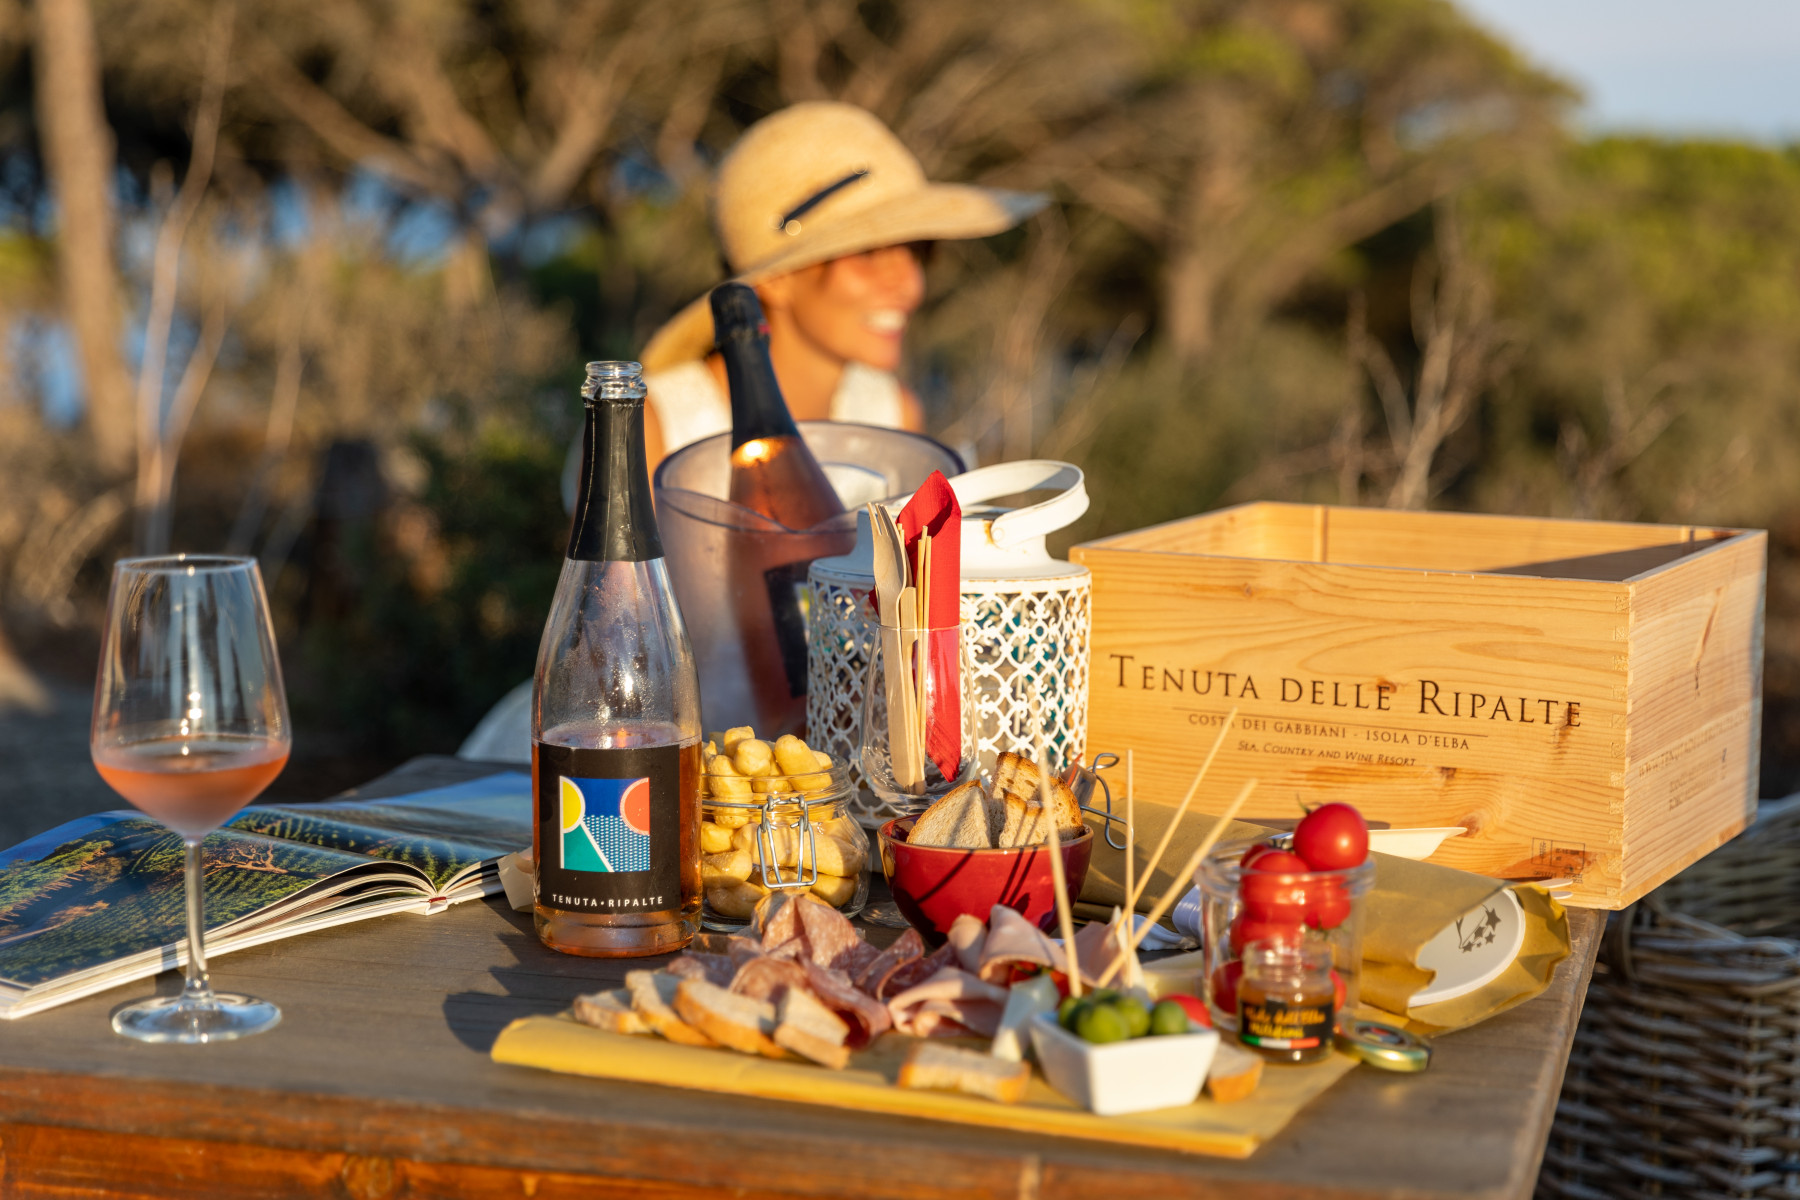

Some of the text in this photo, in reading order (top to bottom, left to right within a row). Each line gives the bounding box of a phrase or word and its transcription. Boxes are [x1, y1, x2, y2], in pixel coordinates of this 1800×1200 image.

[1280, 677, 1392, 712] DELLE
[1241, 718, 1267, 732] DEI
[1274, 721, 1347, 739] GABBIANI
[1366, 729, 1411, 745] ISOLA
[1417, 734, 1470, 751] D'ELBA
